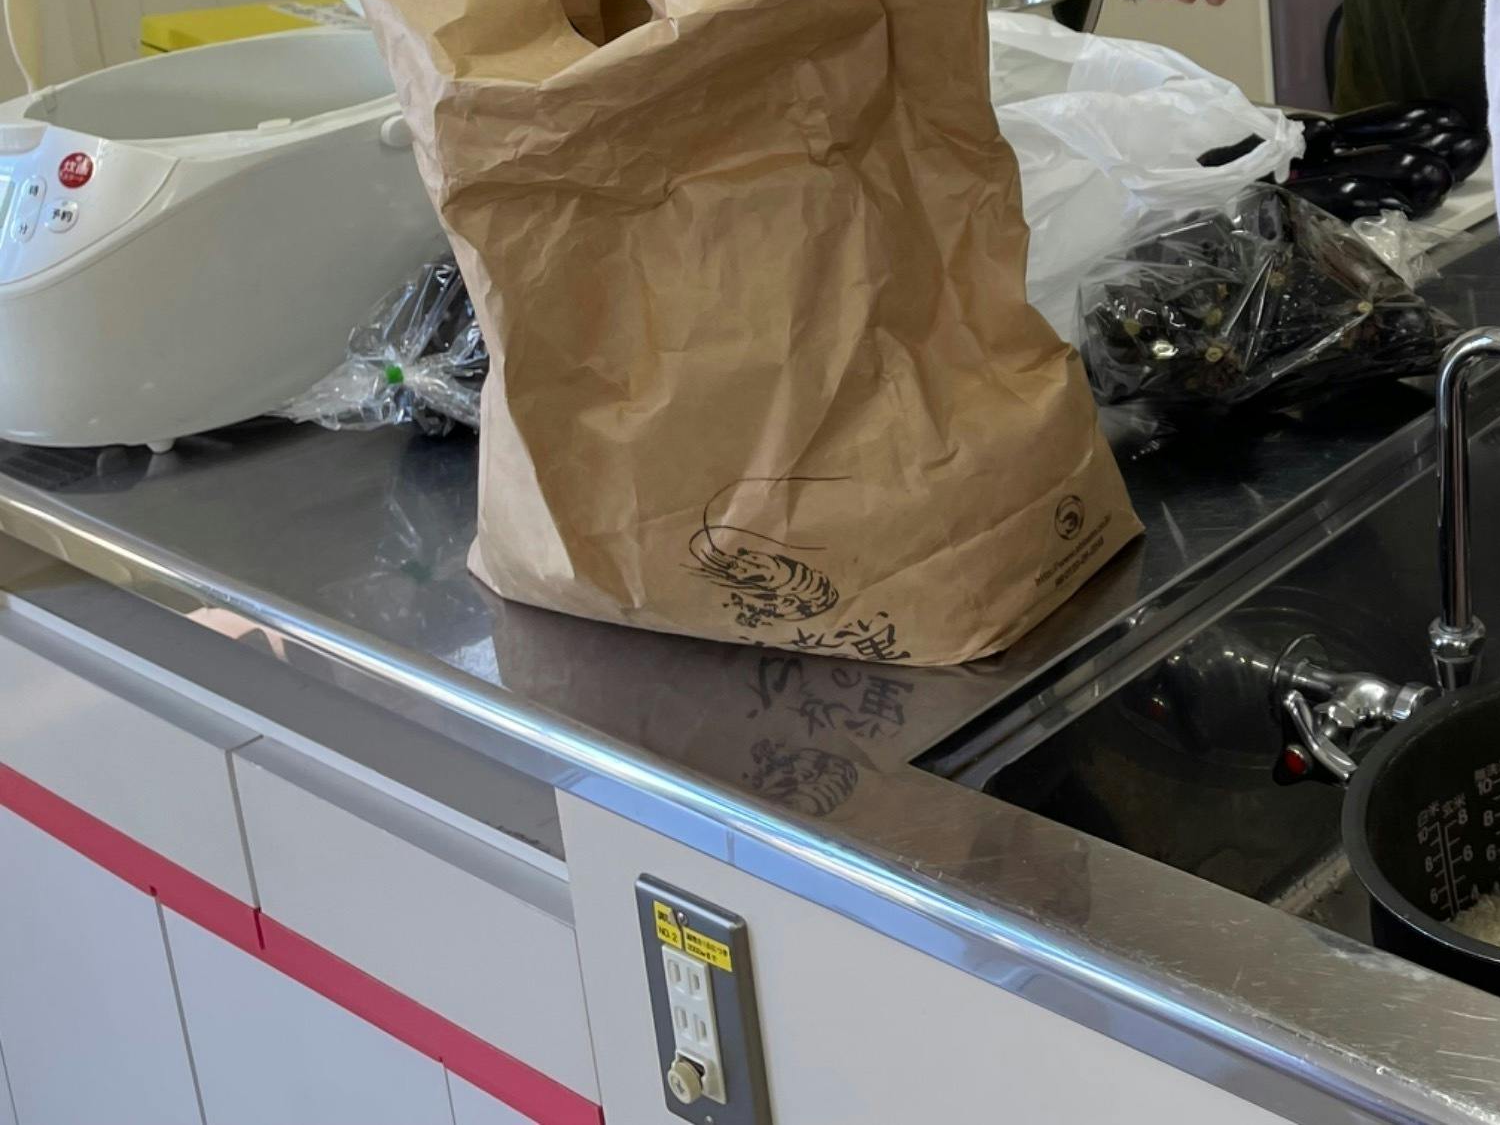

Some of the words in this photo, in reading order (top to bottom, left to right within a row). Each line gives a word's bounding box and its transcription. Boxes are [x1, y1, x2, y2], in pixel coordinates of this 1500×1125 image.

[1478, 777, 1493, 795] 10
[1458, 808, 1468, 825] 8
[1483, 810, 1494, 826] 8
[1463, 844, 1473, 862] 6
[1486, 844, 1496, 861] 6
[1424, 856, 1433, 872] 8
[1430, 887, 1438, 904] 6
